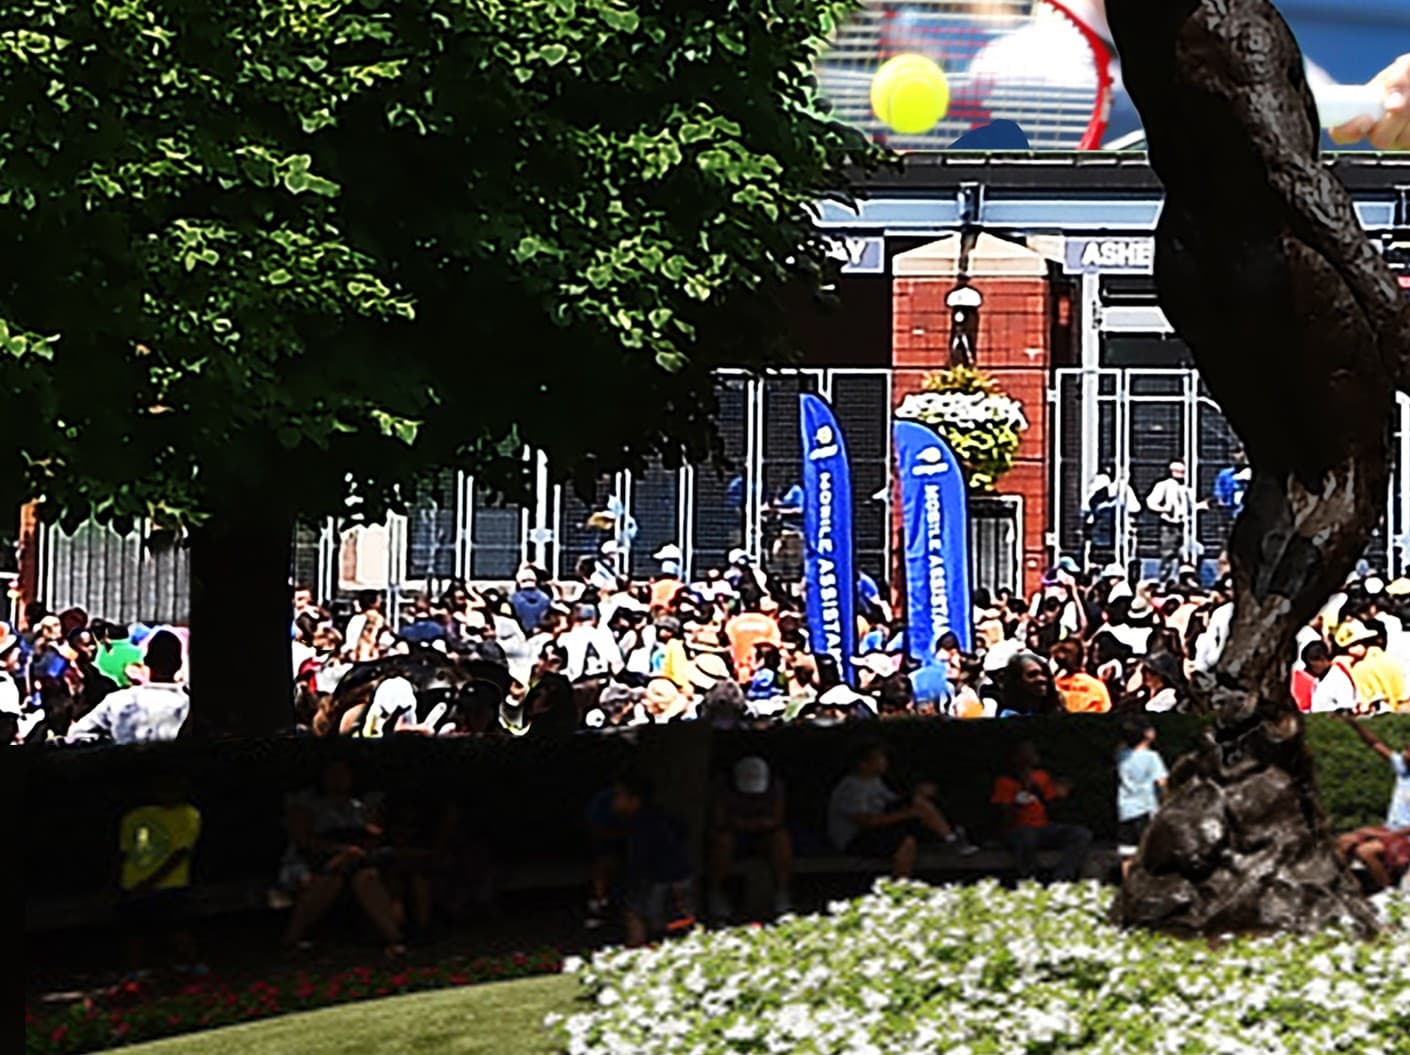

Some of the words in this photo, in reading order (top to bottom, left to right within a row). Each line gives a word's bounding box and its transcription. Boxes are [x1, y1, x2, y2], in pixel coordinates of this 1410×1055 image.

[1081, 242, 1152, 266] ASHE
[817, 472, 833, 555] MOBILE
[924, 484, 942, 551] MOBILE
